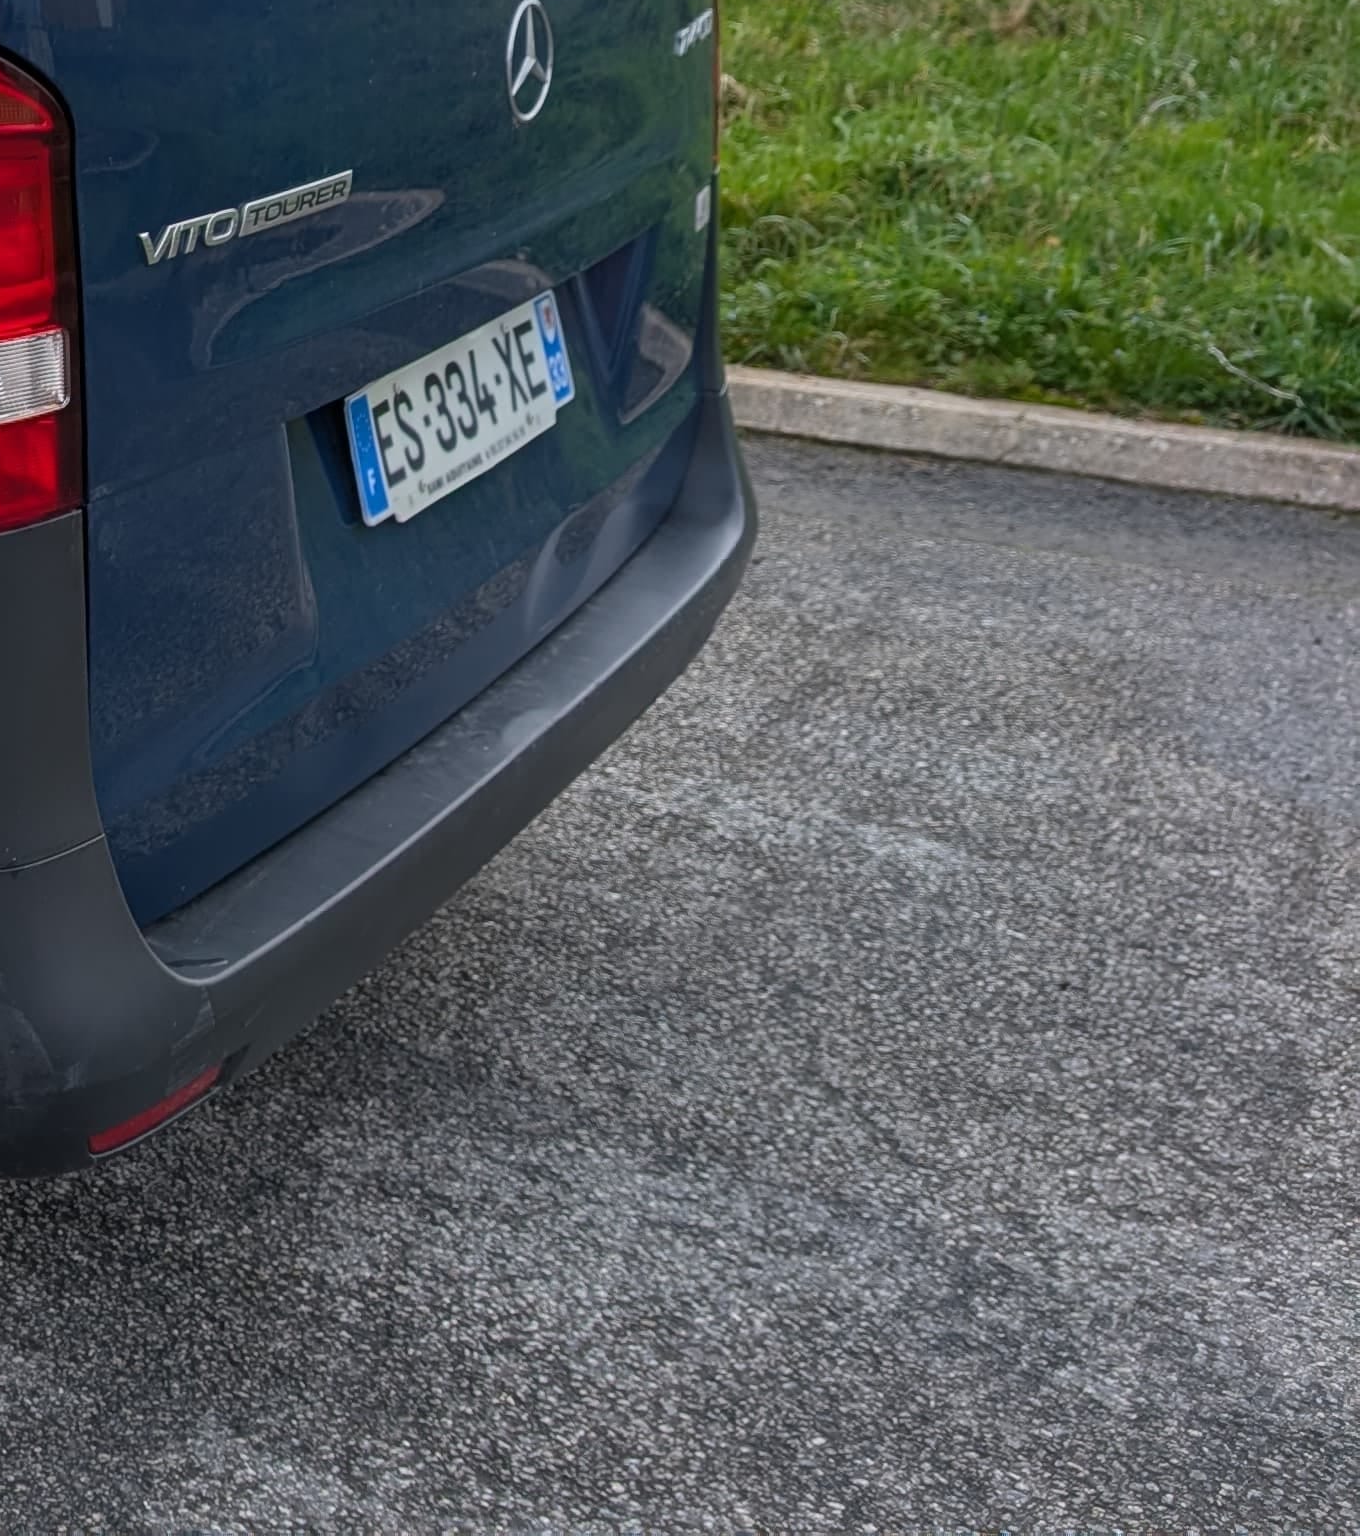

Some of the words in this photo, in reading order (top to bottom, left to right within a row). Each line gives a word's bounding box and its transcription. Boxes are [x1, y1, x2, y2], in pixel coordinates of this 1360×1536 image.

[138, 207, 240, 265] VITO
[248, 179, 348, 227] TOURER
[366, 467, 377, 497] F
